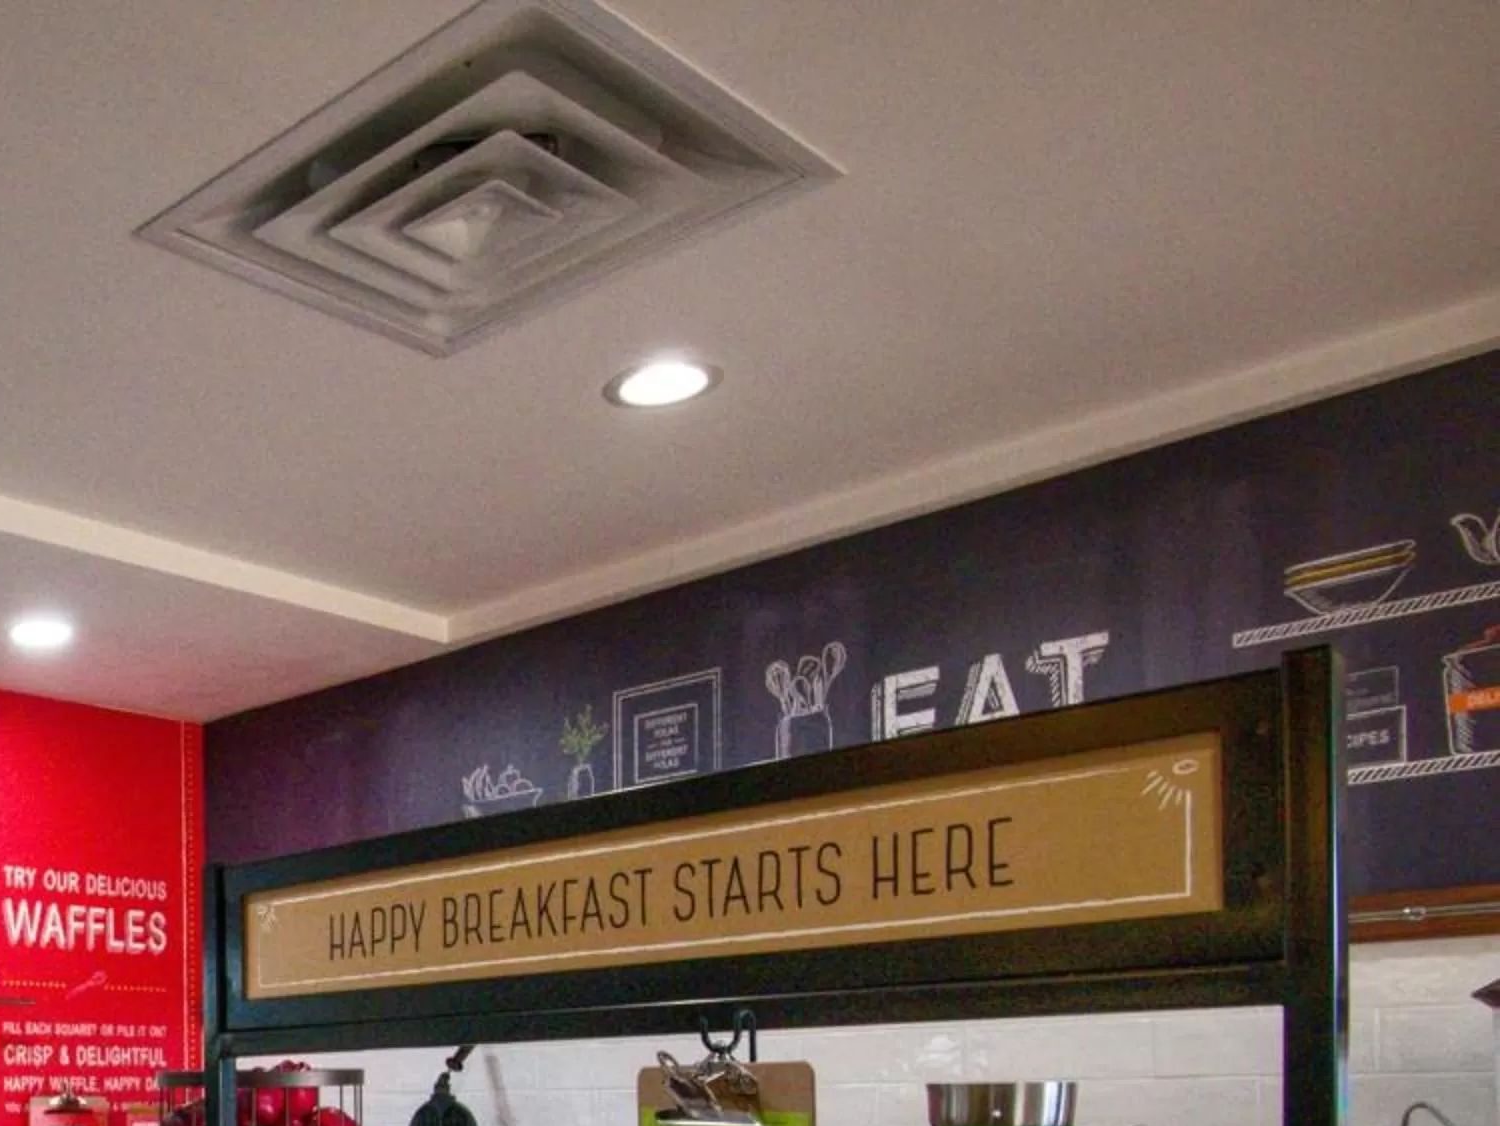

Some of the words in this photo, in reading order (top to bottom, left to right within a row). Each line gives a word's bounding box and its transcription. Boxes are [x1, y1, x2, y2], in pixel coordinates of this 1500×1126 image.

[871, 631, 1109, 741] EAT
[1347, 729, 1390, 749] CIPES
[3, 864, 37, 889] TRY
[43, 868, 81, 894] OUR
[85, 872, 168, 901] DELICIOUS
[329, 901, 426, 960] HAPPY
[443, 868, 652, 949] BREAKFAST
[673, 842, 841, 921] STARTS
[872, 817, 1013, 900] HERE
[2, 897, 168, 956] WAFFLES
[3, 1044, 53, 1067] CRISP
[76, 1044, 168, 1068] DELIGHTFUL
[3, 1076, 45, 1093] HAPPY
[104, 1076, 141, 1093] HAPPY
